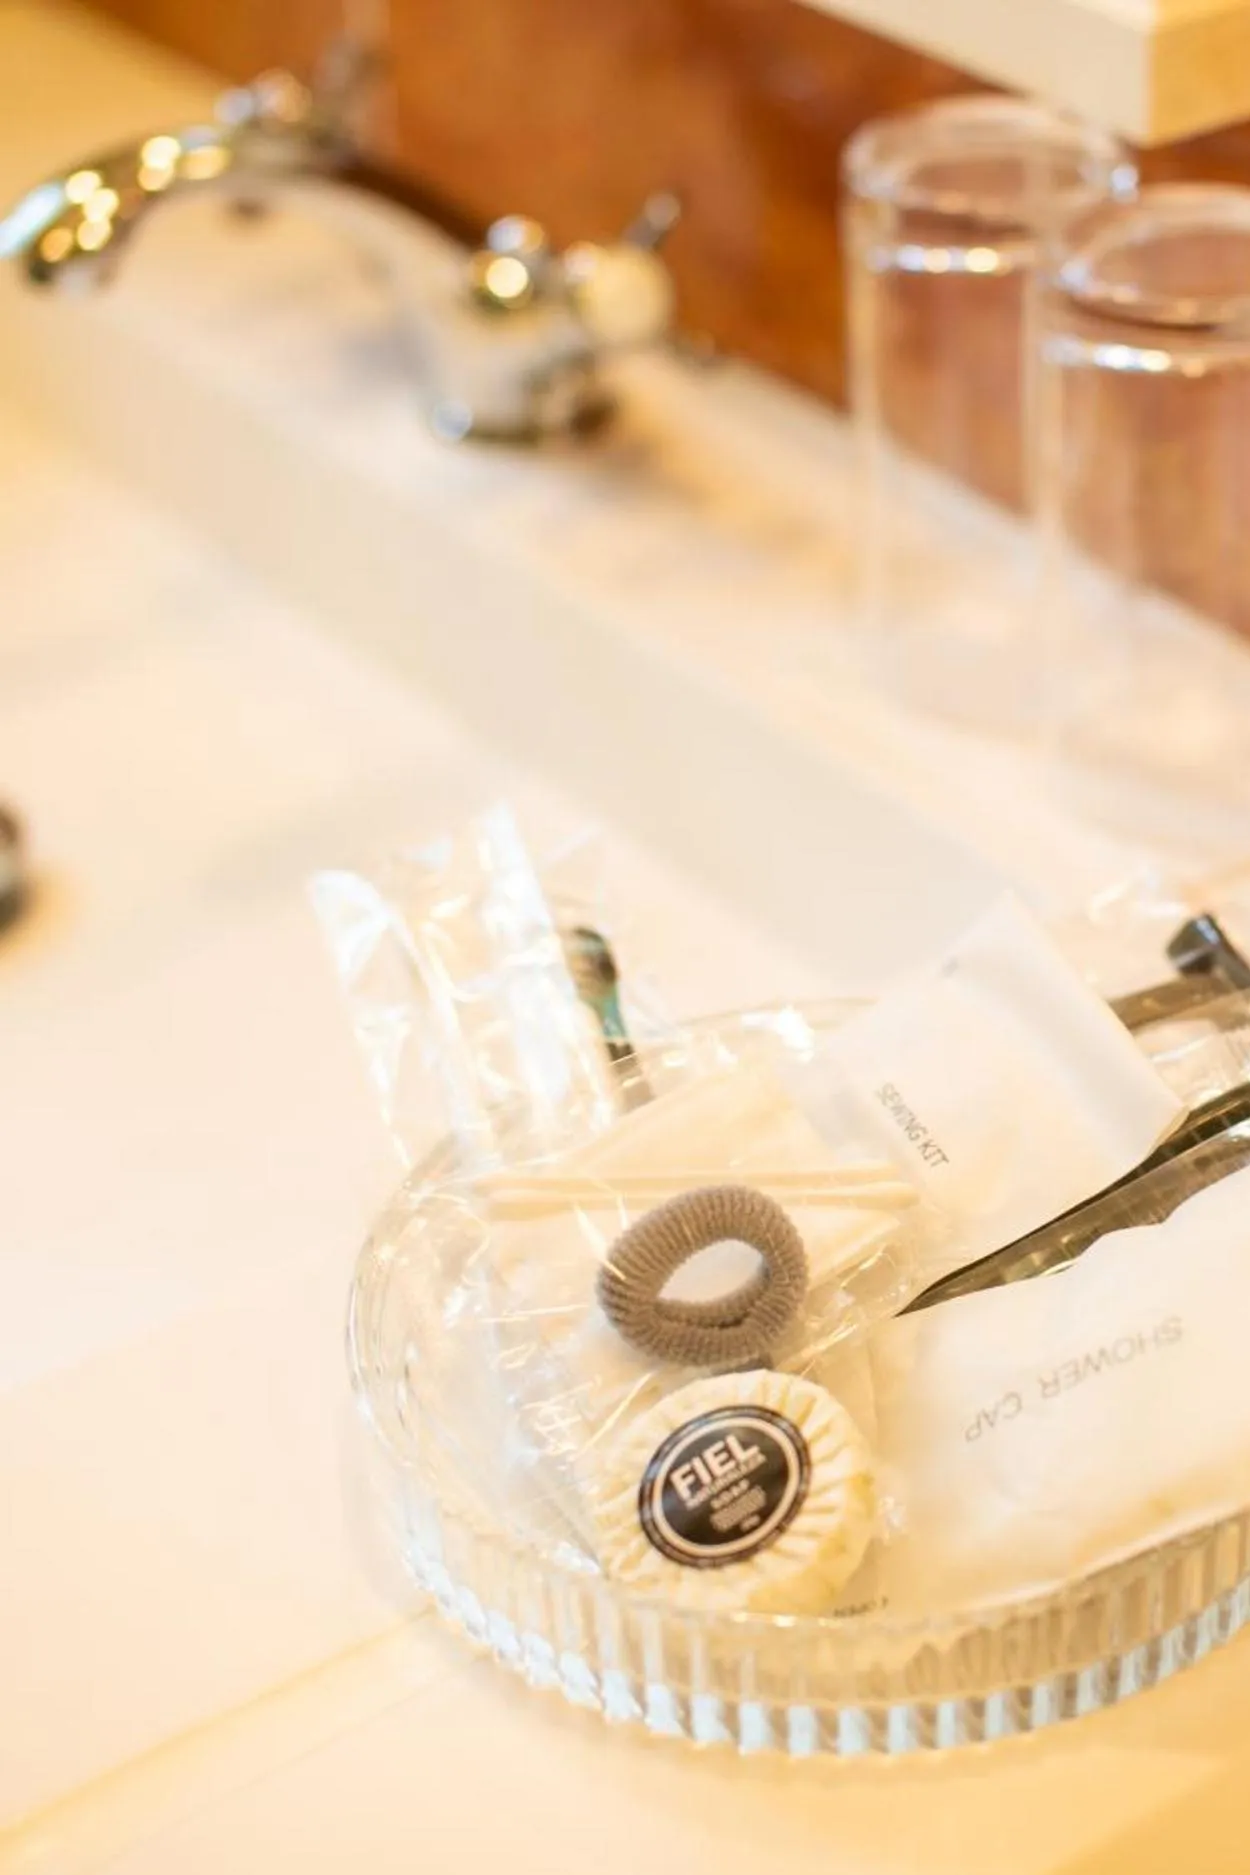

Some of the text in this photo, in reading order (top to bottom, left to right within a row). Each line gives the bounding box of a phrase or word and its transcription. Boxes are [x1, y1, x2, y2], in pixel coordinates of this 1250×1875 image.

[875, 1082, 950, 1168] SEWING KIT
[964, 1316, 1183, 1443] SHOWER CAP
[670, 1434, 760, 1503] FIEL
